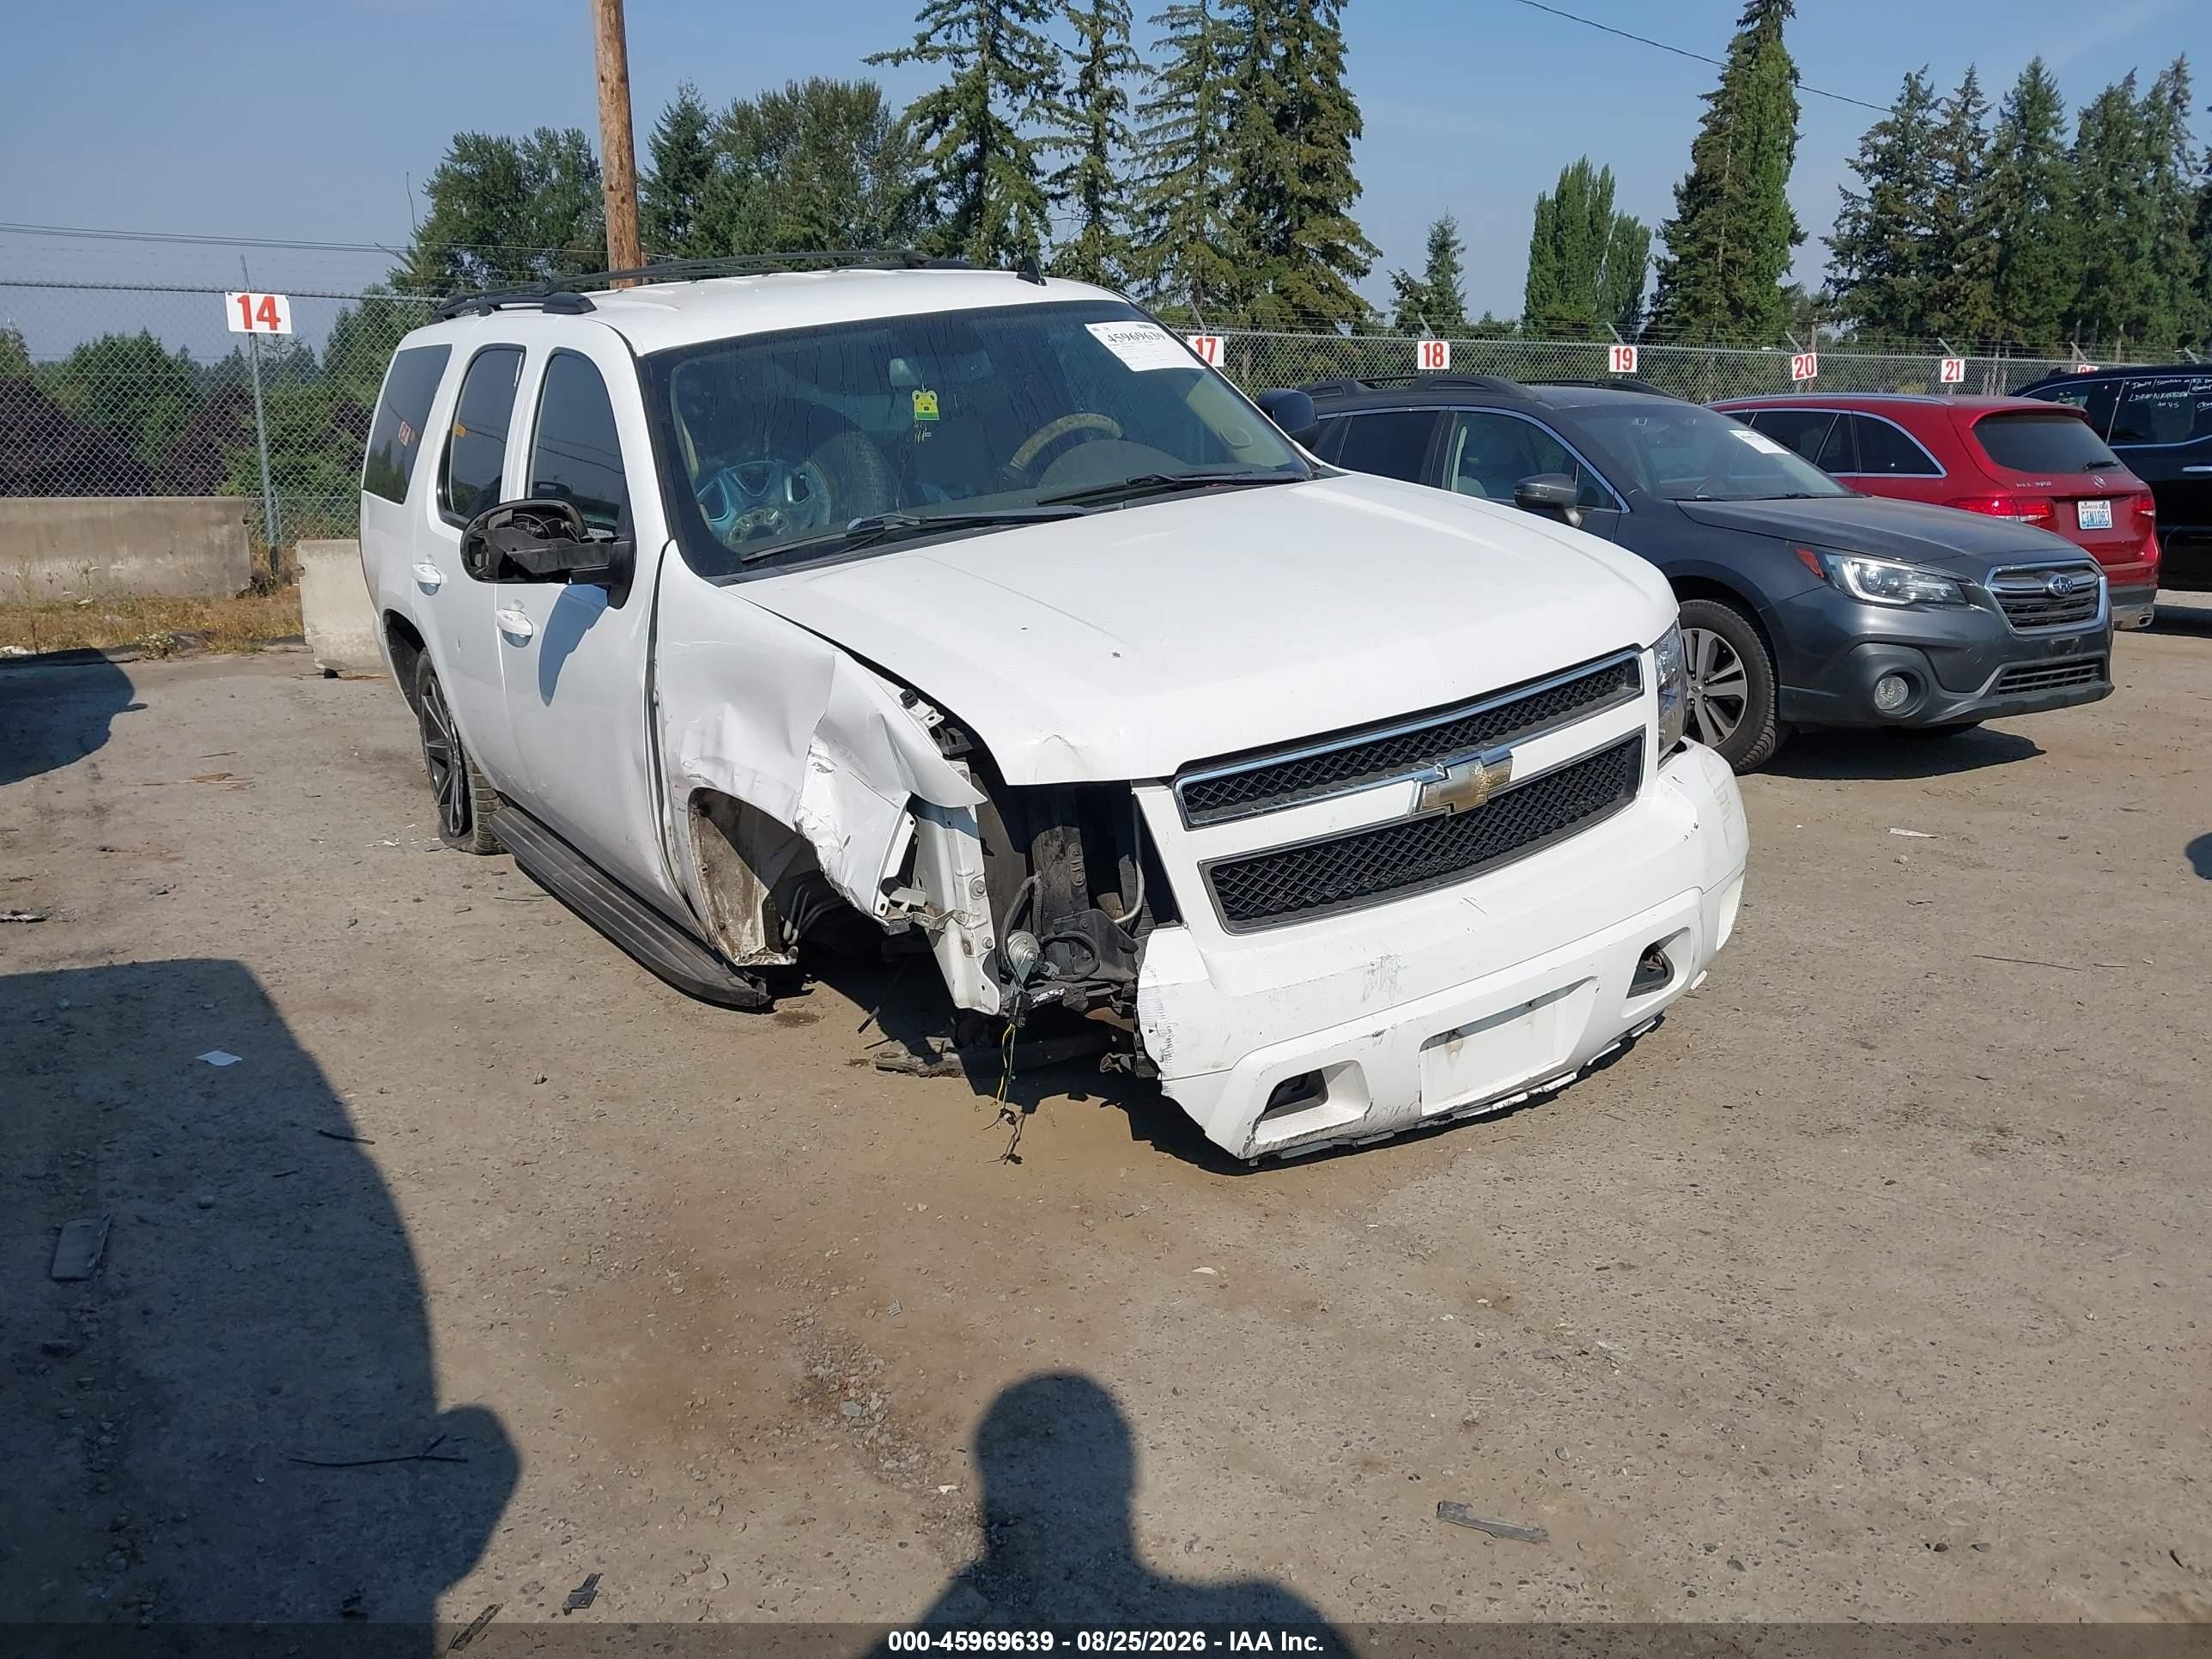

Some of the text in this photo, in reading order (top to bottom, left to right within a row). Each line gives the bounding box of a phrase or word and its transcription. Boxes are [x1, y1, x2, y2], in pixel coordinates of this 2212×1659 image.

[237, 295, 282, 331] 14
[1107, 331, 1166, 343] 45969639
[1195, 337, 1217, 365] 17
[1424, 342, 1444, 368] 18
[1613, 347, 1633, 371] 19
[1794, 355, 1815, 379] 20
[1944, 361, 1961, 381] 21
